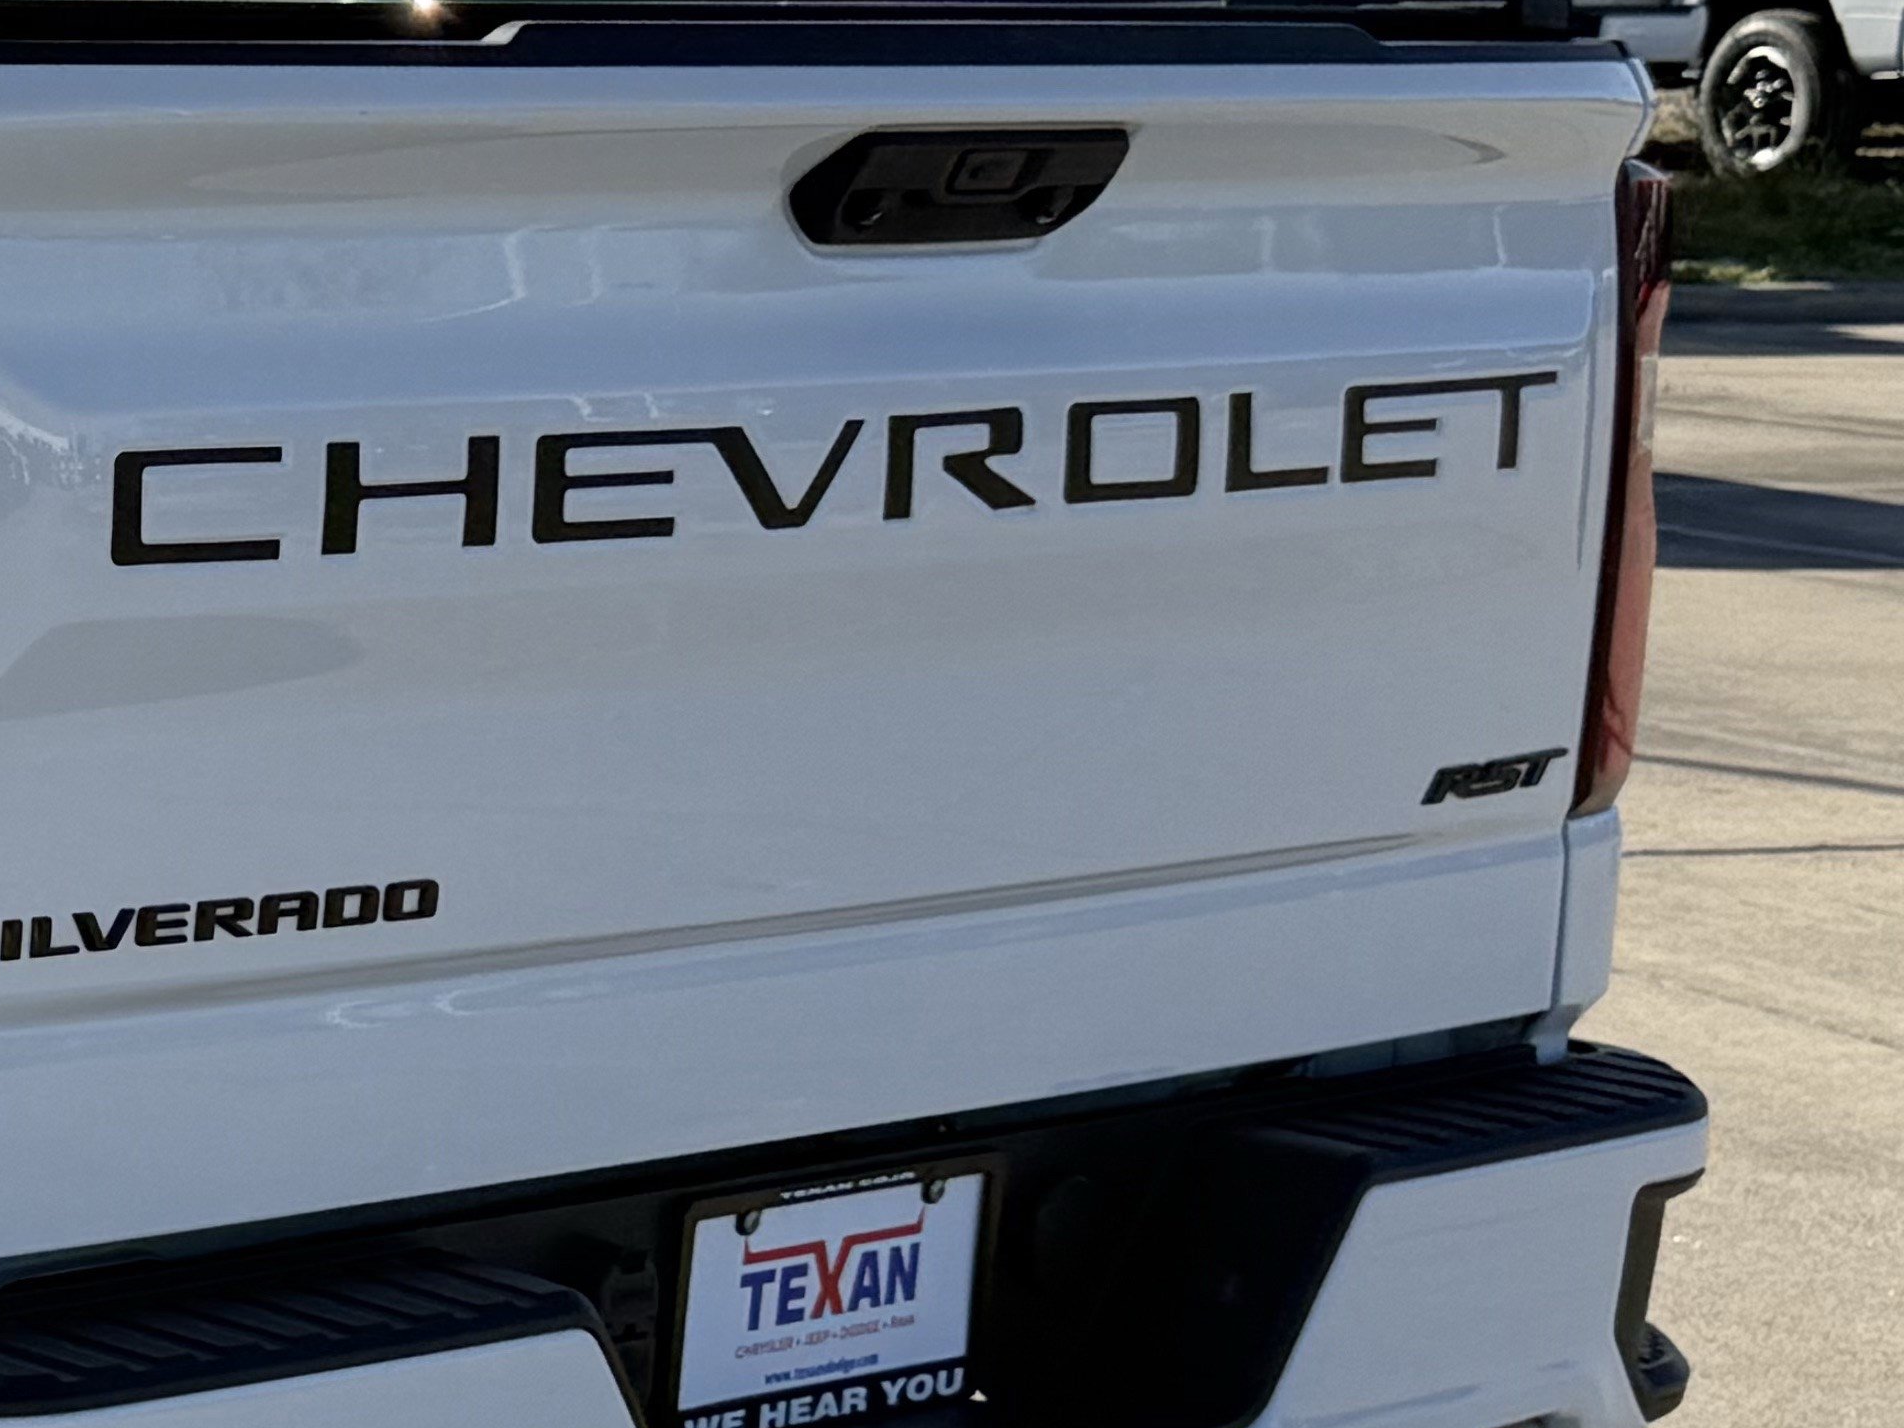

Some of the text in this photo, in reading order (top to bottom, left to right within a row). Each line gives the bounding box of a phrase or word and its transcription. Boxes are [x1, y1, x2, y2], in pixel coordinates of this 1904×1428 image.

[111, 371, 1558, 567] CHEVROLET
[1420, 747, 1569, 806] RST
[740, 1206, 926, 1332] TEXAN
[881, 1367, 965, 1406] YOU
